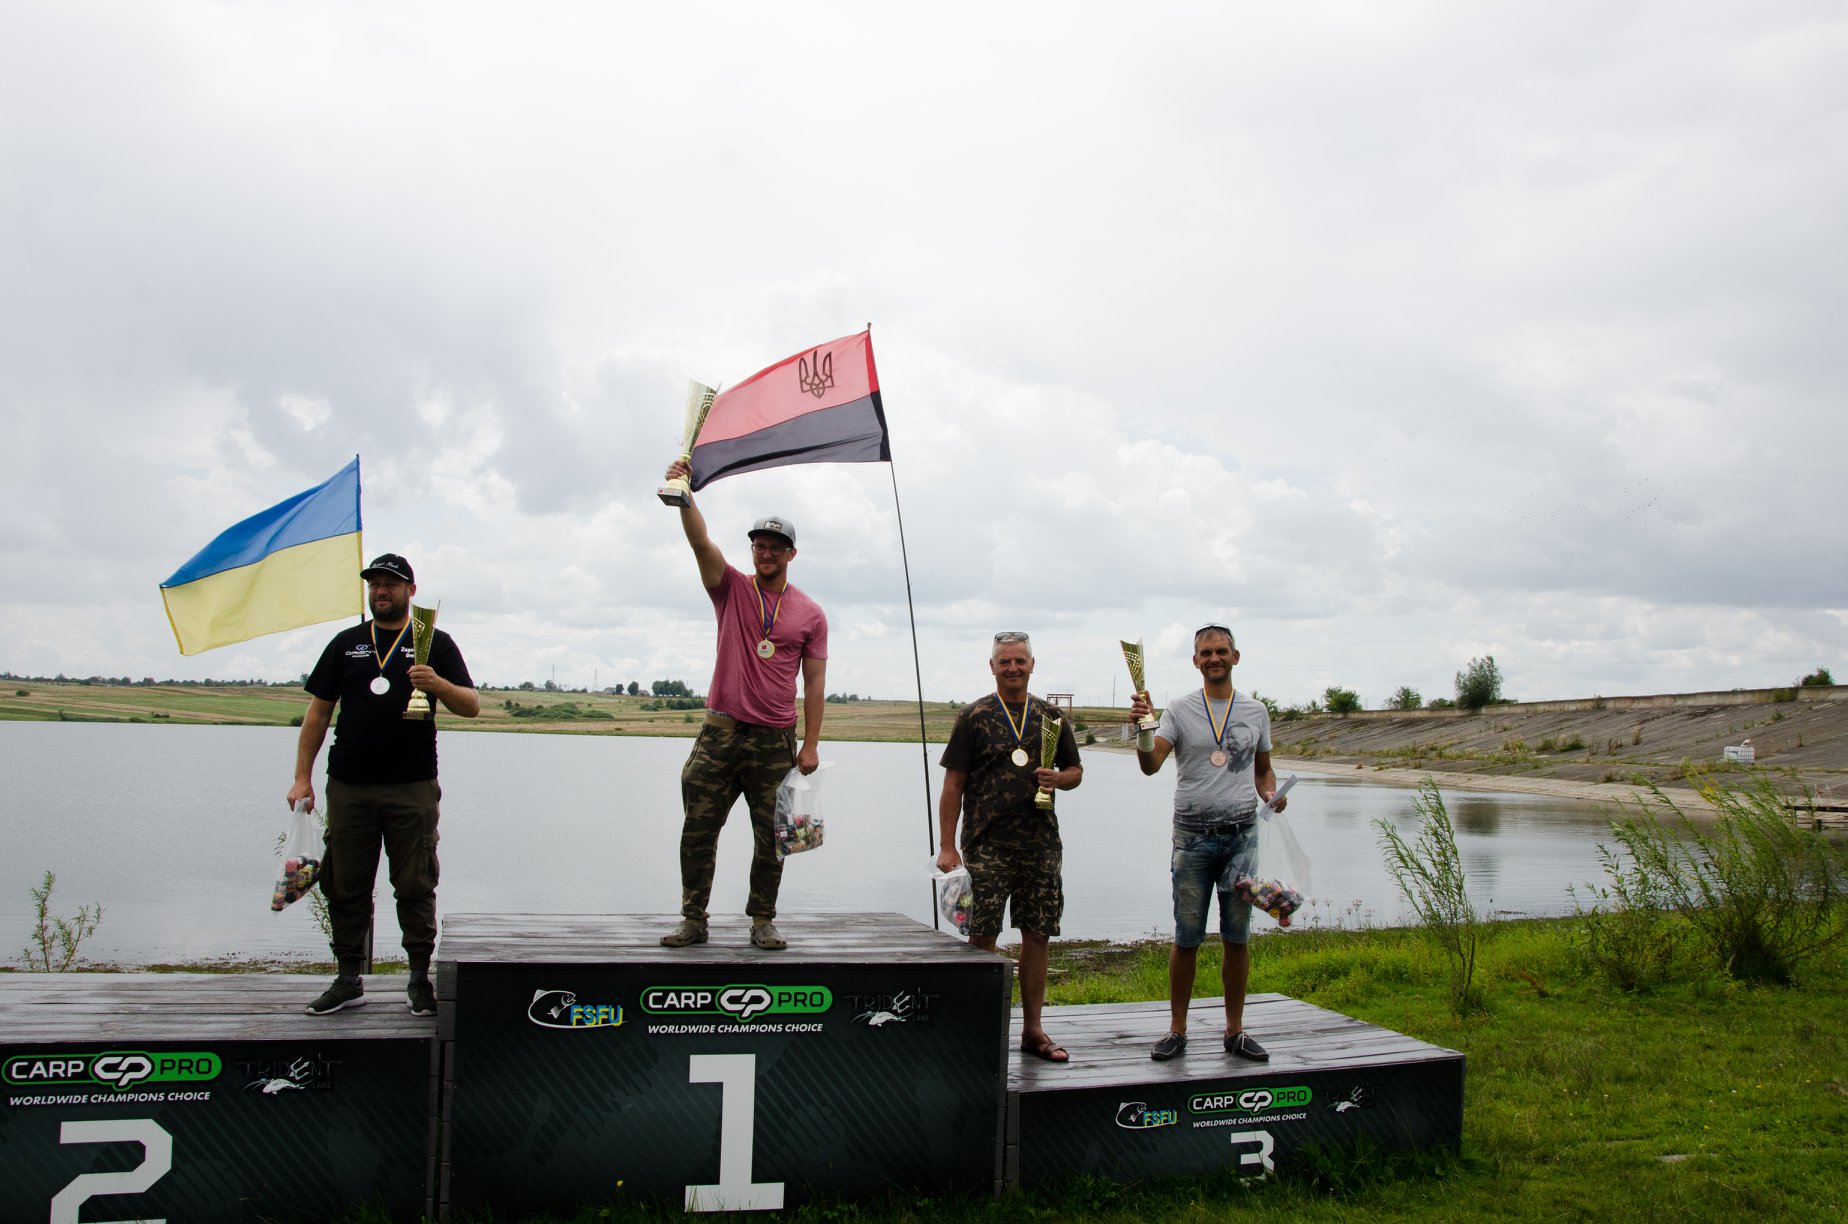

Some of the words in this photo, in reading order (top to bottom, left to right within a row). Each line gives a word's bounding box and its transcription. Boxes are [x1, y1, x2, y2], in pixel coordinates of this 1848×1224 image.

[648, 992, 711, 1008] CARP
[778, 991, 824, 1007] PRO
[570, 1005, 623, 1027] FSFU
[648, 1024, 715, 1034] WORLDWIDE
[717, 1024, 783, 1034] CHAMPIONS
[784, 1023, 823, 1032] CHOICE
[11, 1060, 85, 1079] CARP
[159, 1057, 213, 1075] PRO
[9, 1094, 89, 1106] WORLDWIDE
[90, 1092, 165, 1103] CHAMPIONS
[167, 1091, 211, 1101] CHOICE
[1193, 1095, 1234, 1110] CARP
[1276, 1089, 1307, 1103] PRO
[1143, 1109, 1179, 1127] FSFU
[1192, 1119, 1237, 1128] WORLDWIDE
[1237, 1115, 1281, 1125] CHAMPIONS
[684, 1053, 785, 1214] 1
[1230, 1130, 1275, 1187] 3
[50, 1118, 173, 1224] 2
